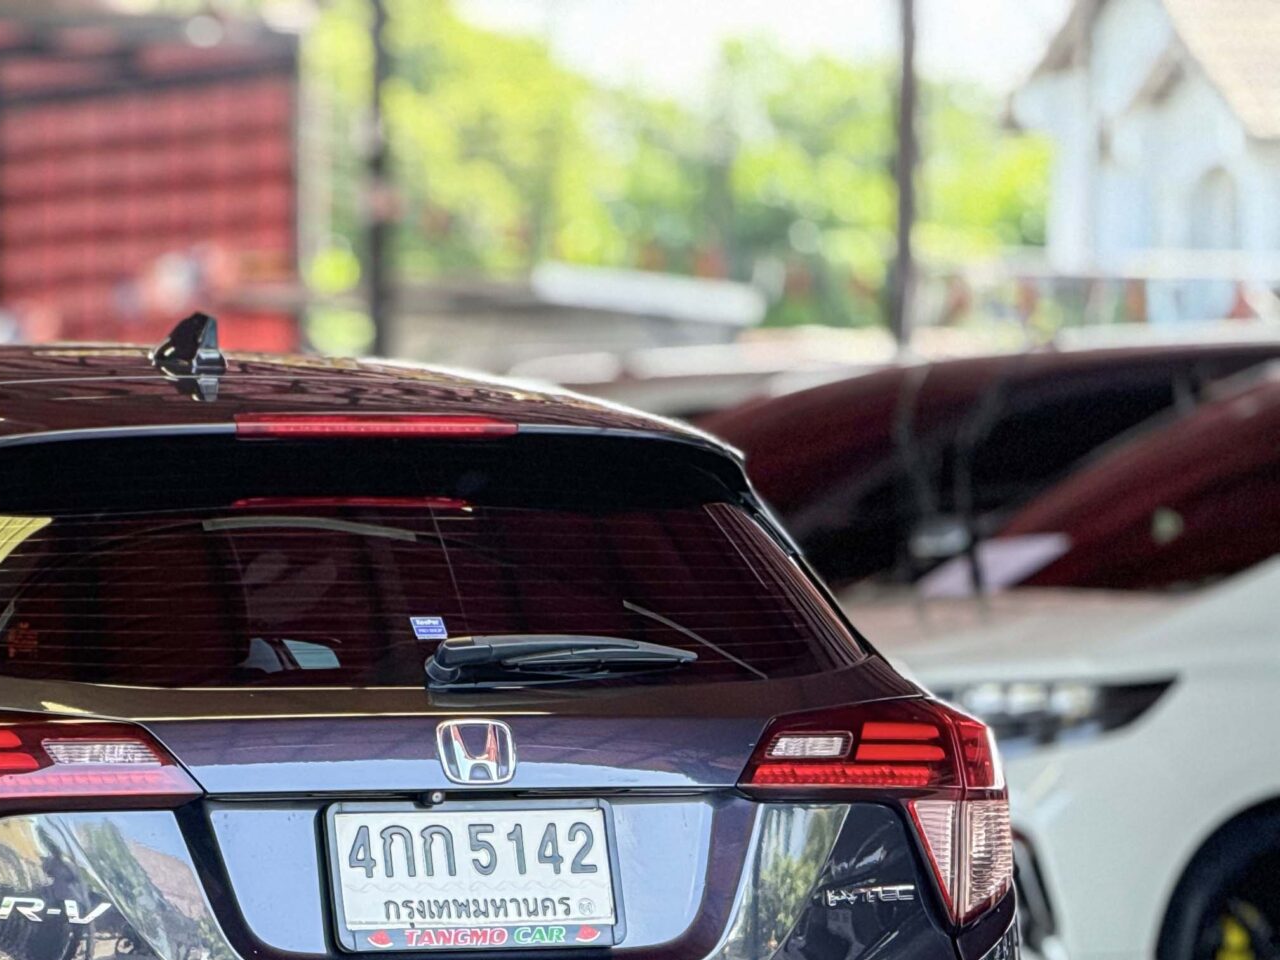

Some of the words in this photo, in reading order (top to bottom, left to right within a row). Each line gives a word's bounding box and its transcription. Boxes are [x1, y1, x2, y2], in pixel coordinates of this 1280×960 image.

[349, 825, 456, 878] 4กก
[468, 822, 598, 875] 5142
[384, 897, 571, 928] กรุงเทพมหานคร
[404, 928, 508, 946] TANGMO
[514, 926, 566, 944] CAR
